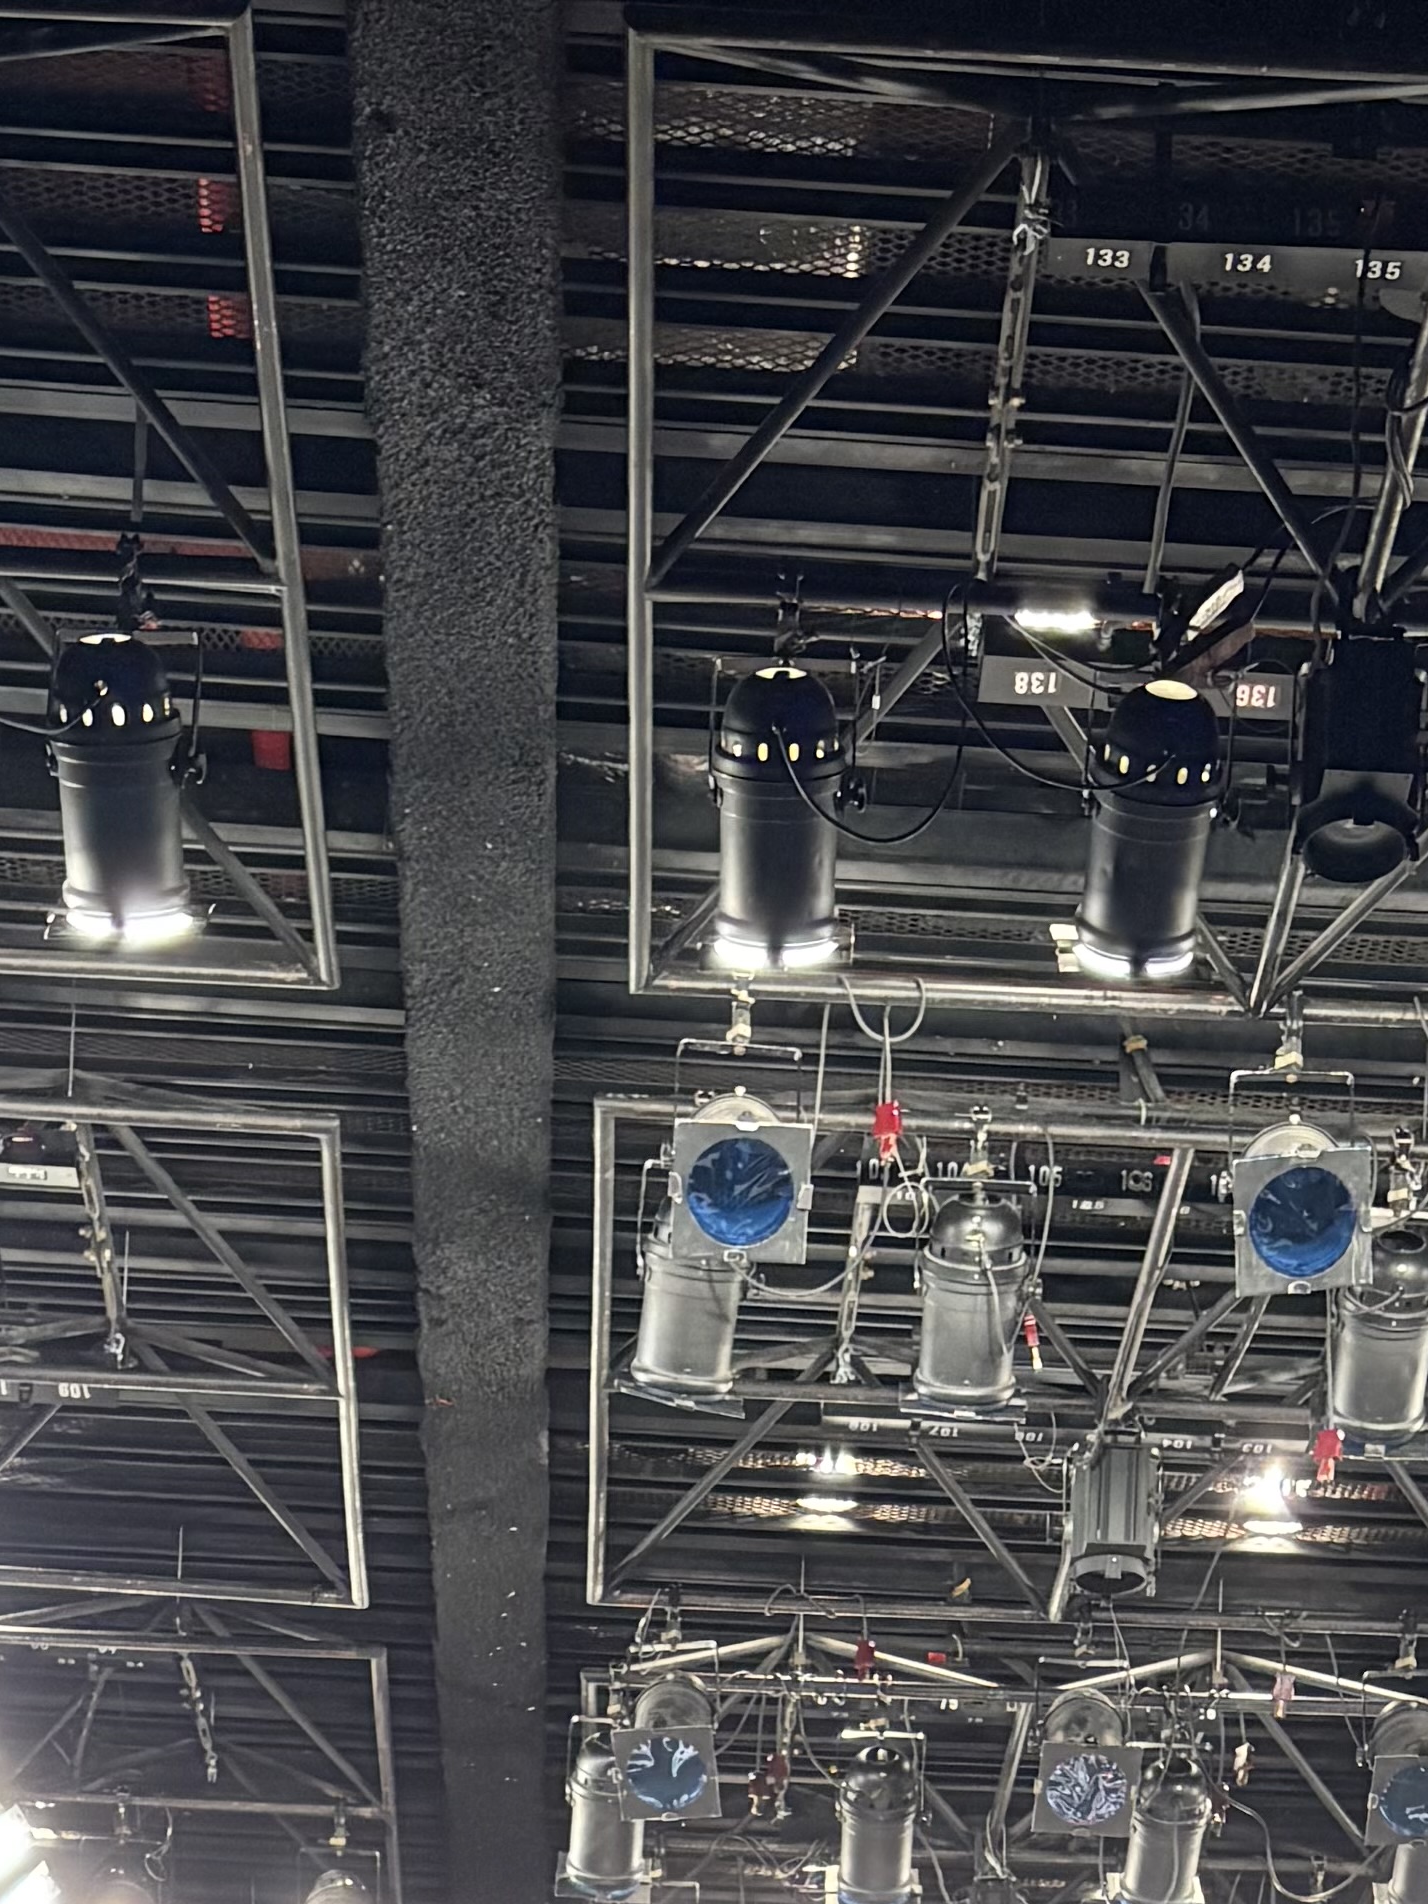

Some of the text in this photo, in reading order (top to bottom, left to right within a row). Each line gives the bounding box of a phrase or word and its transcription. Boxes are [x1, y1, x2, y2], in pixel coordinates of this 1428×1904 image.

[1085, 247, 1130, 269] 133
[1223, 252, 1272, 274] 134
[1354, 258, 1401, 281] 135
